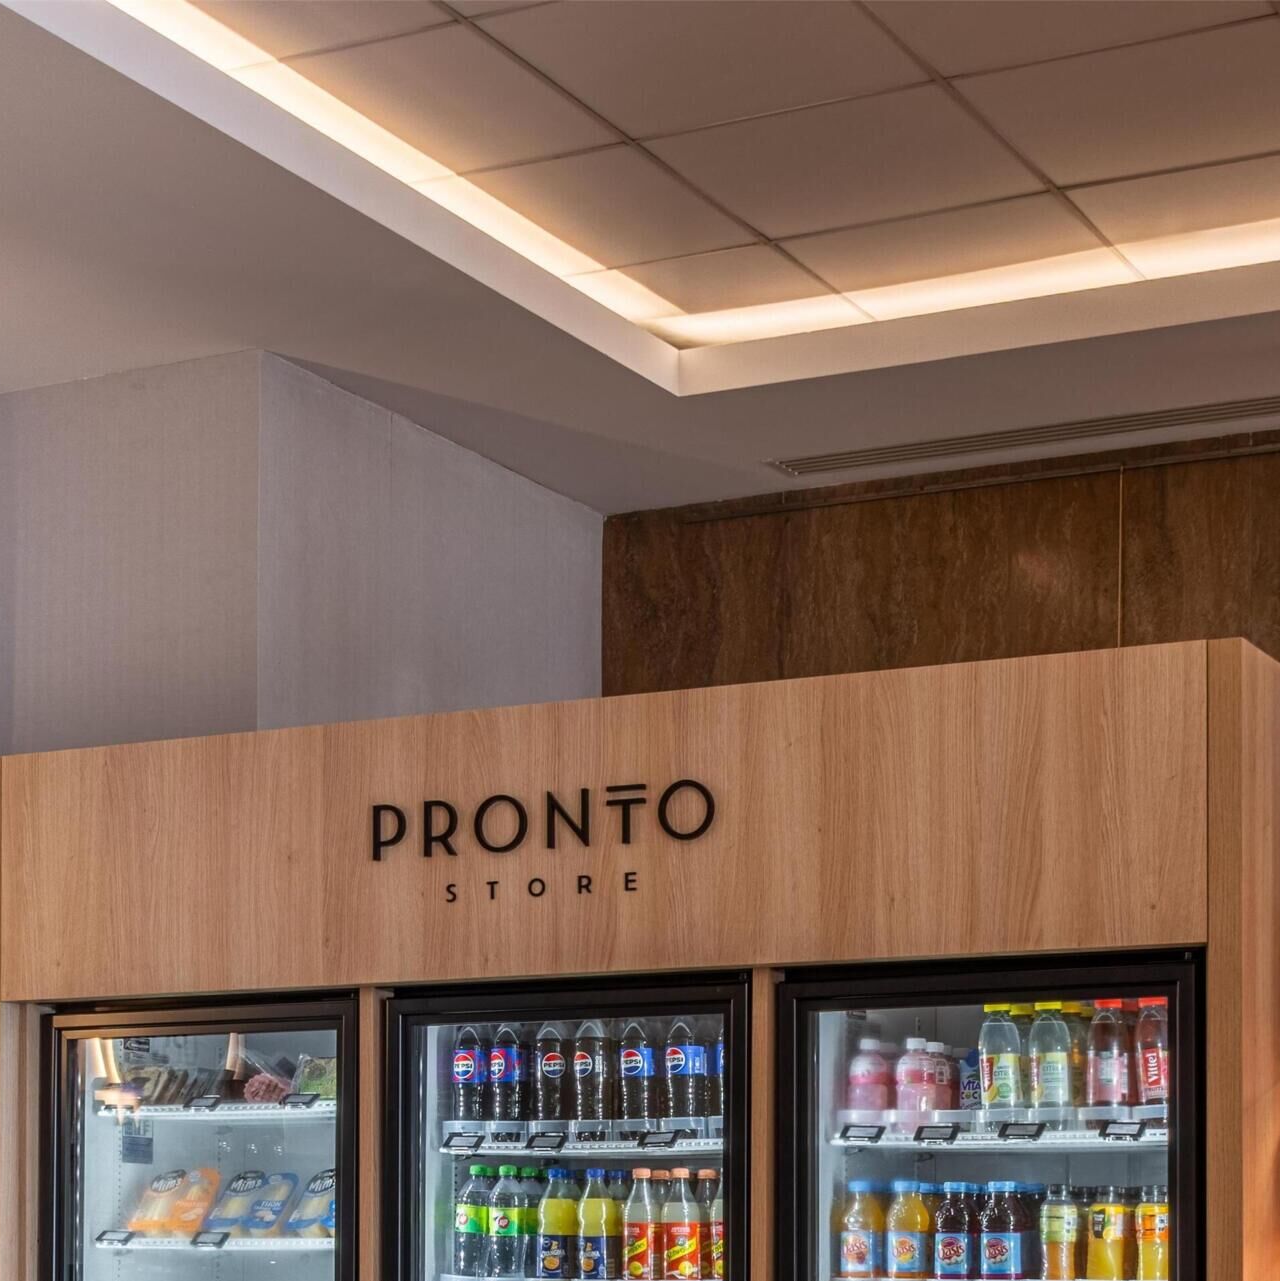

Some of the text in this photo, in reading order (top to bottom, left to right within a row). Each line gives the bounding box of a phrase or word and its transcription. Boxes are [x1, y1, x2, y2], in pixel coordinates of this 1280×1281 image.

[372, 779, 715, 861] PRONTO
[445, 872, 638, 903] STORE
[454, 1061, 473, 1071] PEPSI
[543, 1061, 566, 1070] PEPSI
[622, 1058, 642, 1067] PEPSI
[1146, 1052, 1157, 1082] Vittel
[938, 1244, 965, 1260] Oasis
[984, 1244, 1009, 1259] Oasis
